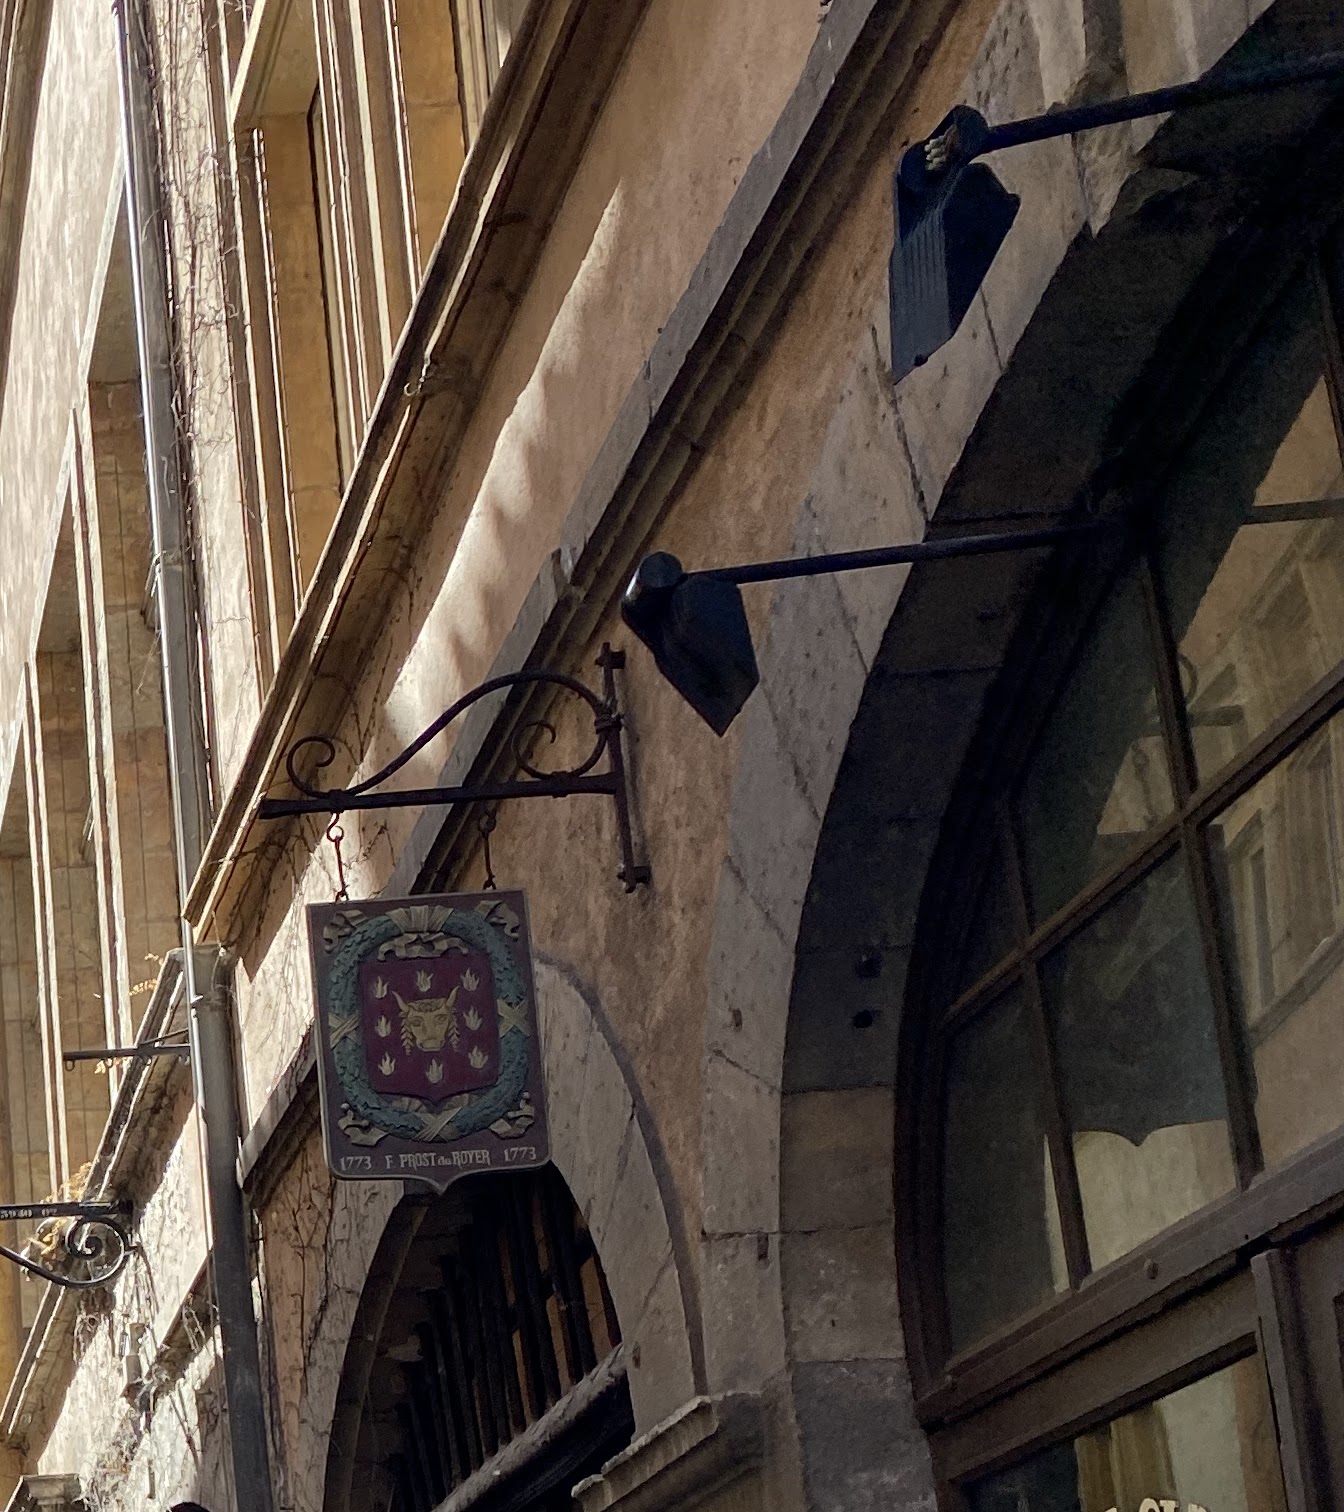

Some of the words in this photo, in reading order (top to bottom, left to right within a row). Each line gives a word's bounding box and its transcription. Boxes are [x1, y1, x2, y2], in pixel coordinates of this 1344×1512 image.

[340, 1156, 371, 1172] 1773
[399, 1152, 438, 1171] PROST
[451, 1149, 492, 1168] ROYER
[504, 1146, 537, 1161] 1773
